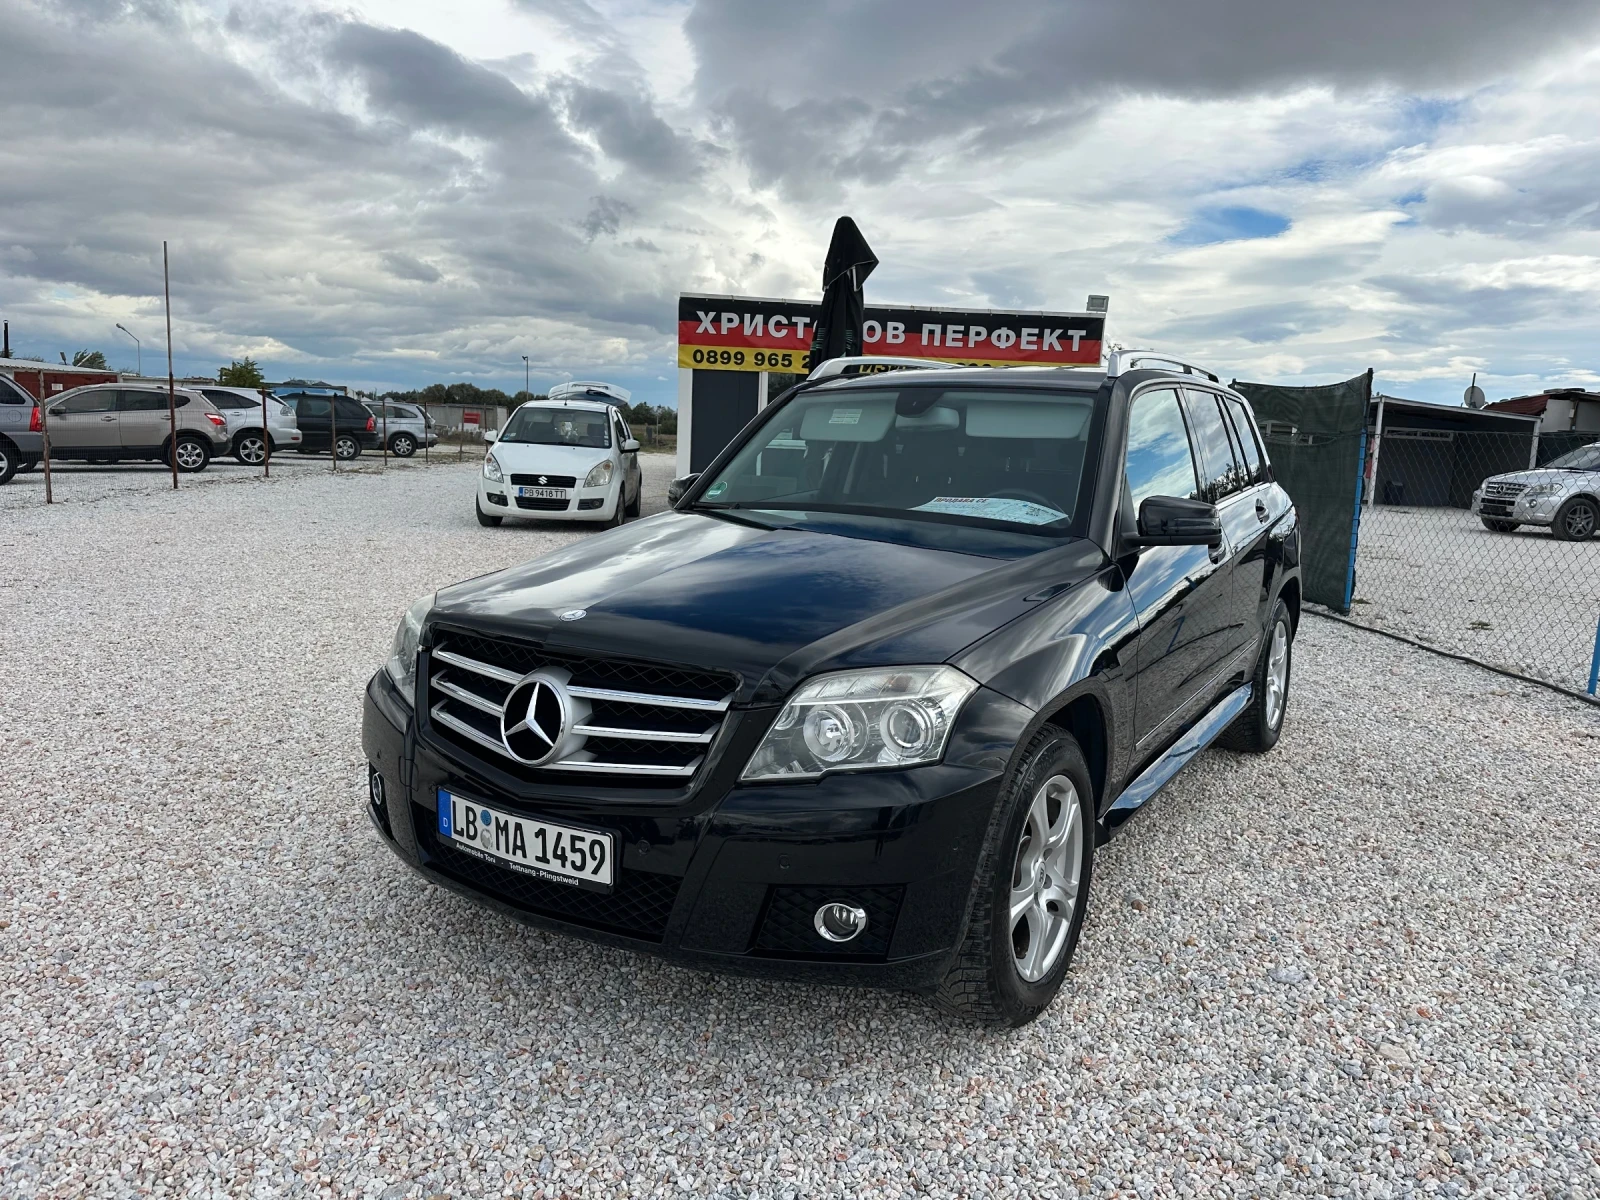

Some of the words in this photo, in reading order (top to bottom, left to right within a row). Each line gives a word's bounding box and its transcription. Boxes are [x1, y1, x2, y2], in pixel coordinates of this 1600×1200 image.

[921, 323, 1086, 351] ПЕРФЕКТ
[692, 349, 745, 366] 0899
[753, 352, 793, 368] 965
[443, 817, 448, 828] D
[452, 800, 478, 841] LB
[495, 816, 528, 859] MA
[534, 827, 606, 876] 1459
[456, 842, 484, 859] Automobile
[485, 853, 496, 864] Toni
